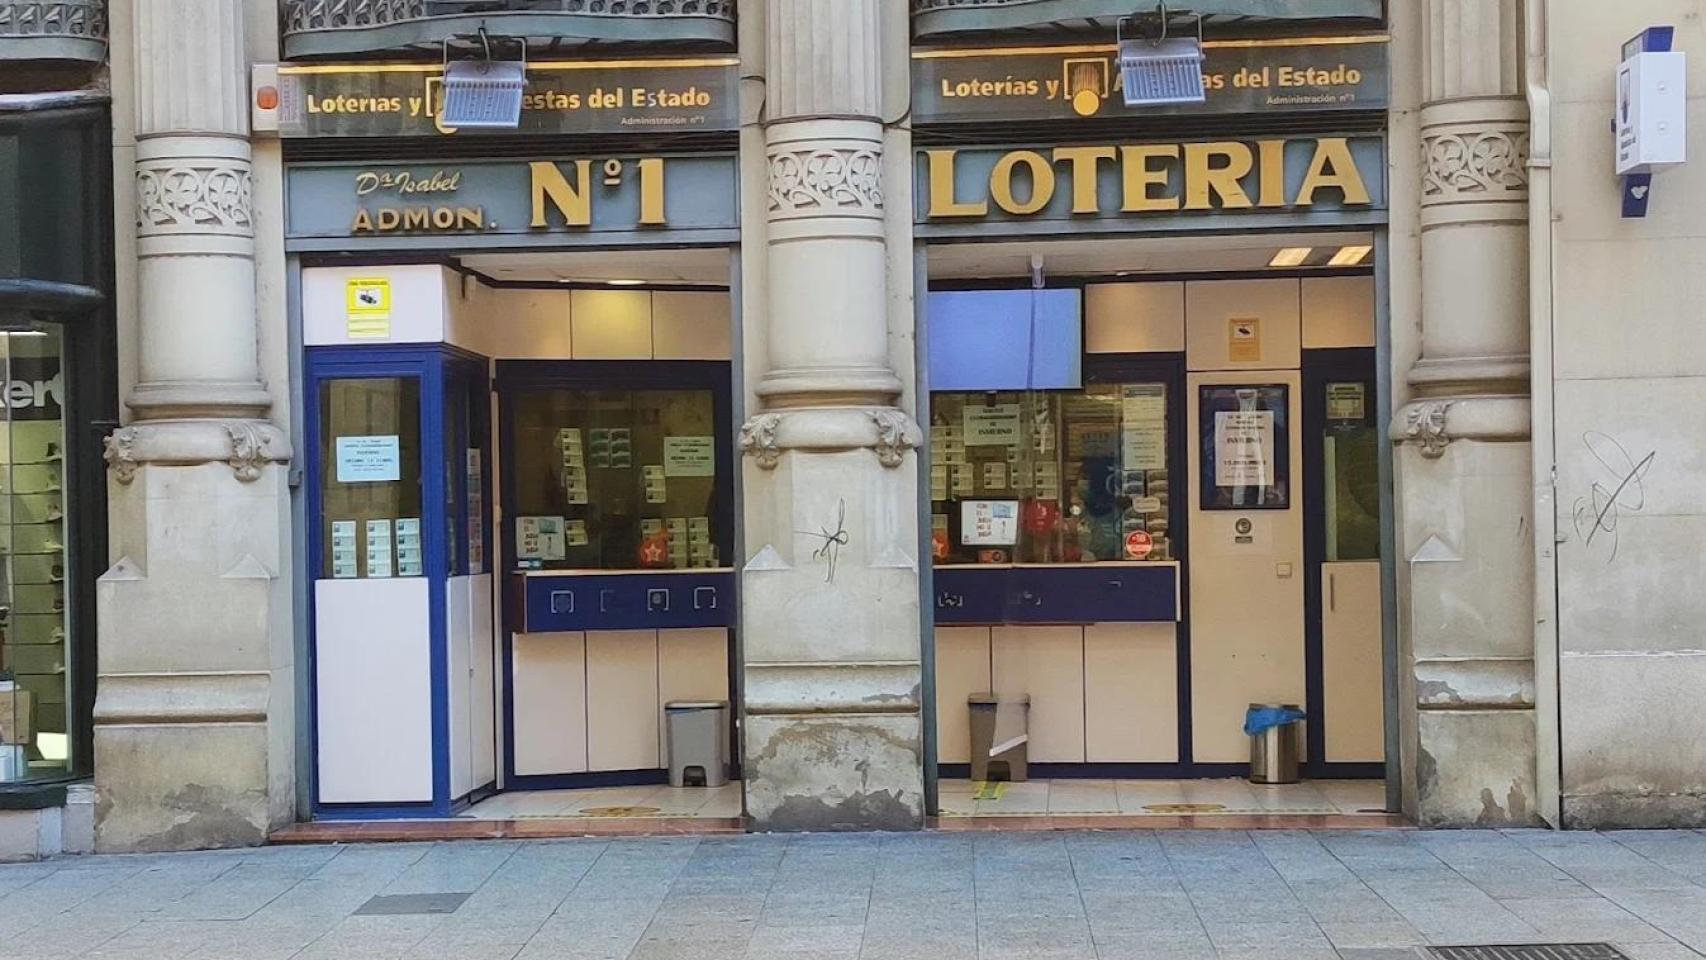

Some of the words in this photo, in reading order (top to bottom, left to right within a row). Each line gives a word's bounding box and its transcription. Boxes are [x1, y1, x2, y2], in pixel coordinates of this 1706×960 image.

[941, 75, 1040, 97] Loterías
[1045, 79, 1060, 100] y
[1232, 67, 1270, 89] del
[1277, 64, 1362, 87] Estado
[408, 97, 422, 116] y
[521, 90, 581, 110] estas
[588, 88, 624, 109] del
[631, 86, 711, 108] Estado
[394, 170, 461, 194] Isabel
[924, 137, 1372, 219] LOTERIA
